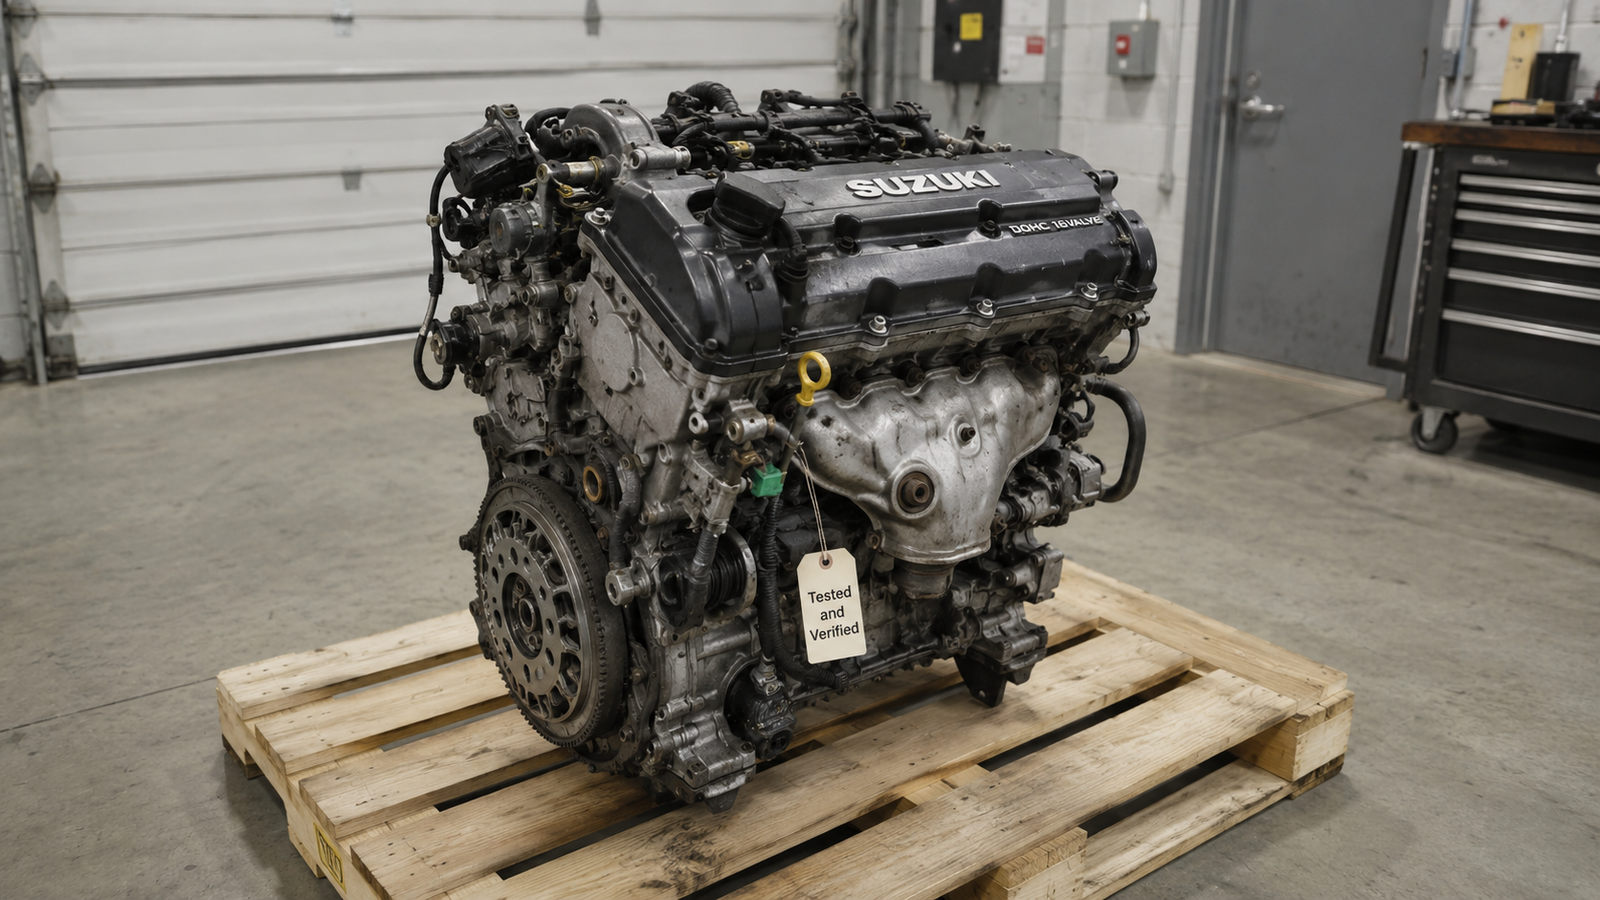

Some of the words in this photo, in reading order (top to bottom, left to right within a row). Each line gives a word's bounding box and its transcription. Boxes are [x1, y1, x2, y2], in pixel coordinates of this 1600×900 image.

[846, 169, 1000, 198] SUZUKI
[1008, 222, 1051, 234] DOHC
[807, 585, 852, 604] Tested
[820, 605, 845, 621] and
[809, 621, 860, 641] Verified
